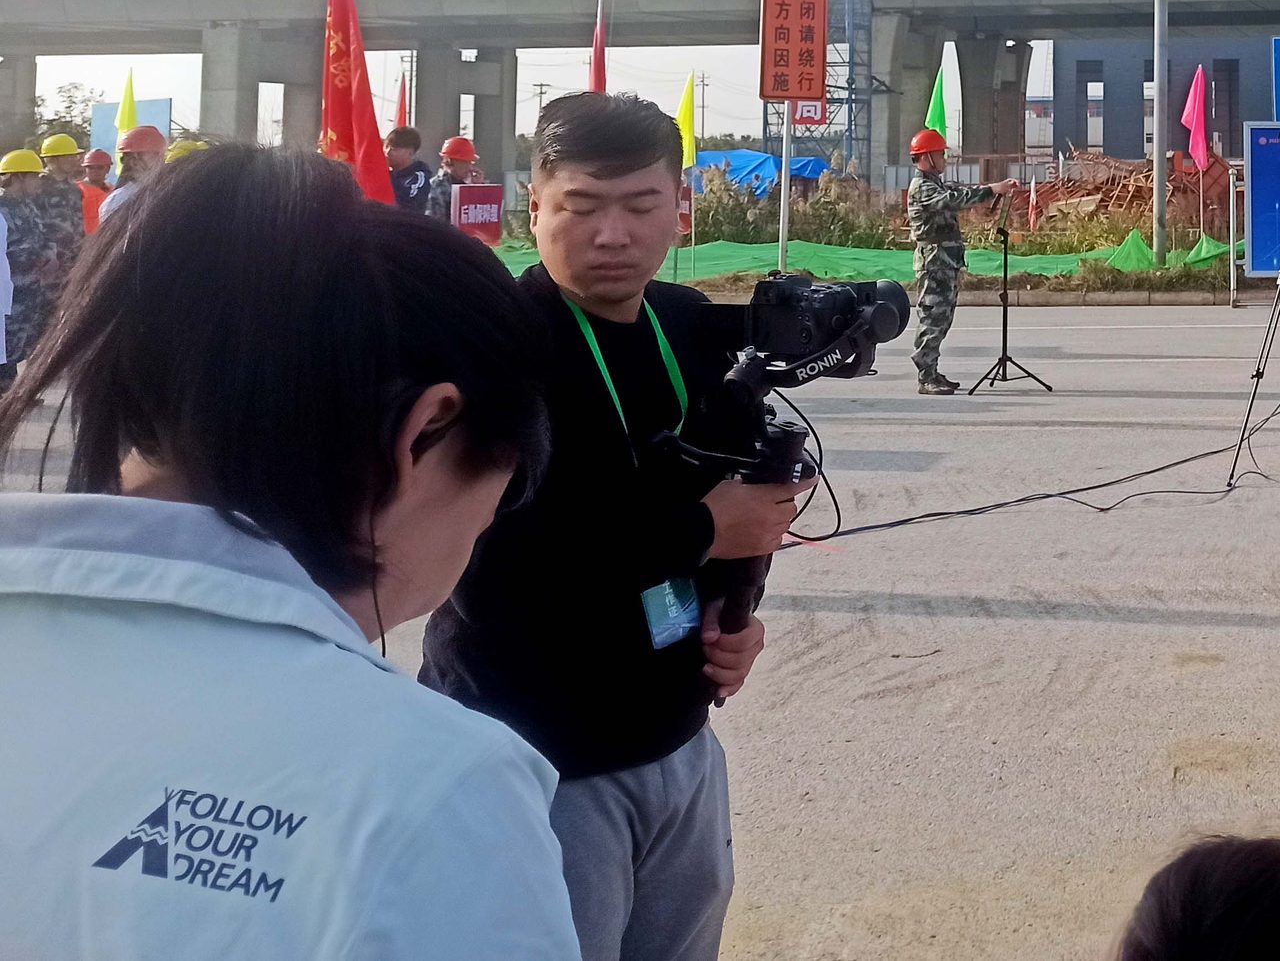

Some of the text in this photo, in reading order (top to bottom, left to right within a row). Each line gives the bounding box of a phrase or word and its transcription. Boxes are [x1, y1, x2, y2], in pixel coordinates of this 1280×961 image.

[795, 349, 842, 380] RONIN
[175, 789, 308, 839] FOLLOW
[174, 820, 258, 862] YOUR
[174, 853, 285, 903] DREAM
